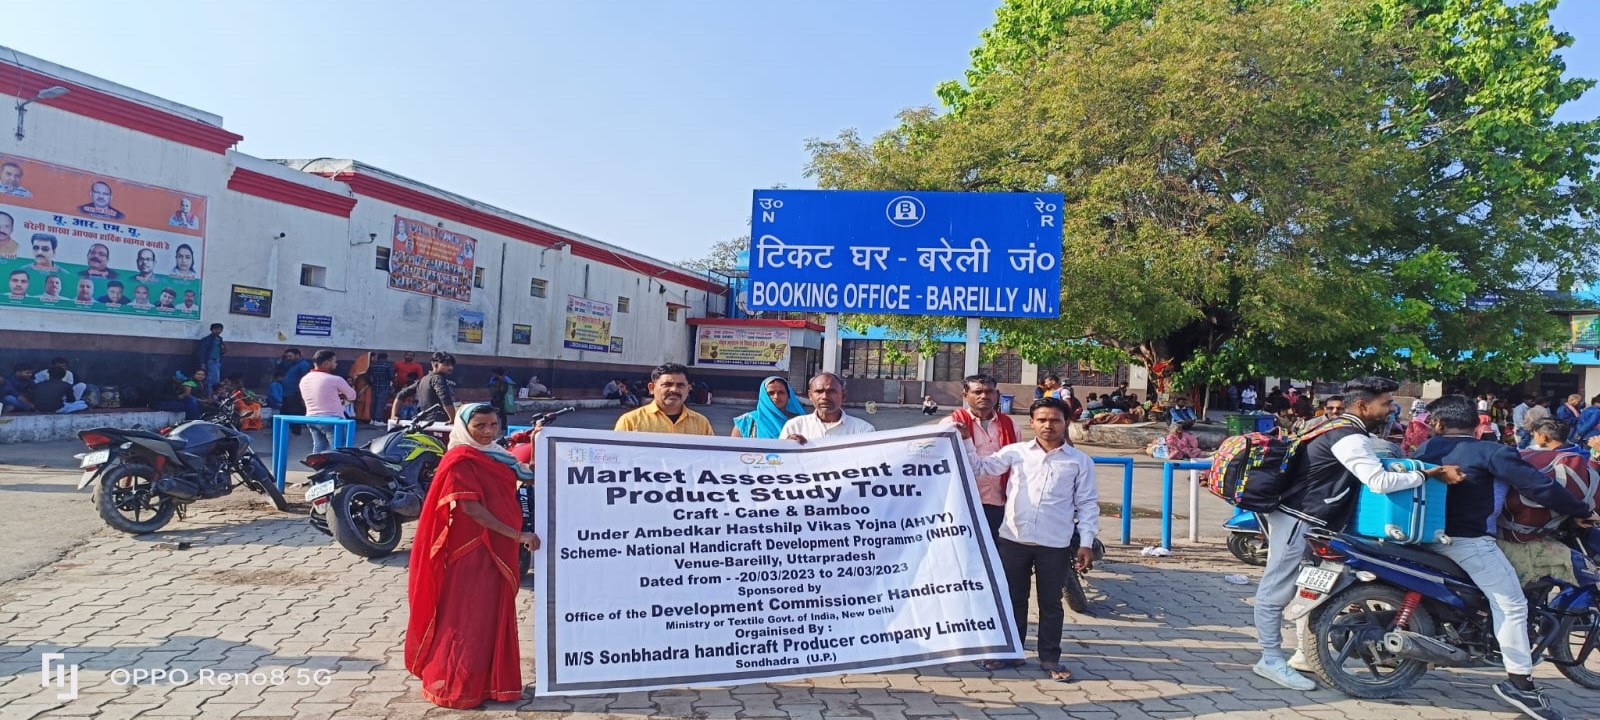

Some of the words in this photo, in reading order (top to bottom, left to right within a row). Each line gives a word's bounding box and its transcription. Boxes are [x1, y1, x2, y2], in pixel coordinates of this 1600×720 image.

[762, 211, 774, 223] N
[900, 202, 911, 213] B
[1040, 215, 1055, 228] R
[757, 234, 835, 269] टिकट
[849, 245, 891, 271] घर
[917, 237, 991, 273] बरेली
[753, 281, 838, 308] BOOKING
[843, 283, 911, 310] OFFICE
[926, 286, 1019, 313] BAREILLY
[1022, 287, 1053, 313] JN.
[567, 466, 686, 485] Market
[697, 461, 893, 485] Assessment
[902, 459, 951, 477] and
[606, 487, 740, 505] Product
[750, 484, 842, 502] Study
[851, 480, 922, 498] Tour.
[673, 507, 719, 521] Craft
[735, 507, 780, 518] Cane
[786, 505, 798, 517] &
[804, 504, 870, 516] Bamboo
[577, 529, 630, 541] Under
[634, 525, 722, 539] Ambedkar
[726, 520, 802, 535] Hastshilp
[807, 519, 851, 532] Vikas
[855, 518, 897, 533] Yojna
[900, 512, 954, 531] (AHVY)
[560, 546, 622, 560] Scheme-
[626, 543, 685, 557] National
[692, 539, 763, 554] Handicraft
[766, 537, 850, 551] Development
[853, 533, 923, 549] Programme
[926, 525, 972, 542] (NHDP)
[674, 555, 782, 570] Venue-Bareilly,
[787, 551, 876, 566] Uttarpradesh
[640, 575, 684, 588] Dated
[687, 573, 722, 586] from
[819, 569, 832, 579] to
[837, 562, 909, 578] 24/03/2023
[564, 611, 605, 623] Office
[608, 610, 622, 620] of
[626, 608, 647, 619] the
[651, 599, 764, 618] Development
[769, 592, 884, 611] Commissioner
[887, 579, 984, 601] Handicrafts
[738, 584, 804, 598] Sponsored
[807, 583, 822, 595] by
[665, 619, 710, 630] Ministry
[713, 619, 725, 627] or
[727, 616, 764, 626] Textile
[767, 614, 795, 625] Govt.
[797, 612, 808, 622] of
[810, 611, 839, 621] India,
[841, 609, 865, 619] New
[868, 605, 895, 616] Delhi
[564, 651, 594, 667] M/S
[599, 646, 690, 665] Sonbhadra
[694, 640, 778, 658] handicraft
[783, 633, 856, 652] Producer
[860, 626, 932, 645] company
[936, 617, 996, 635] Limited
[735, 625, 805, 639] Orgainised
[808, 624, 824, 635] By
[736, 656, 800, 669] Sondhadra
[806, 652, 837, 665] (U.P.)
